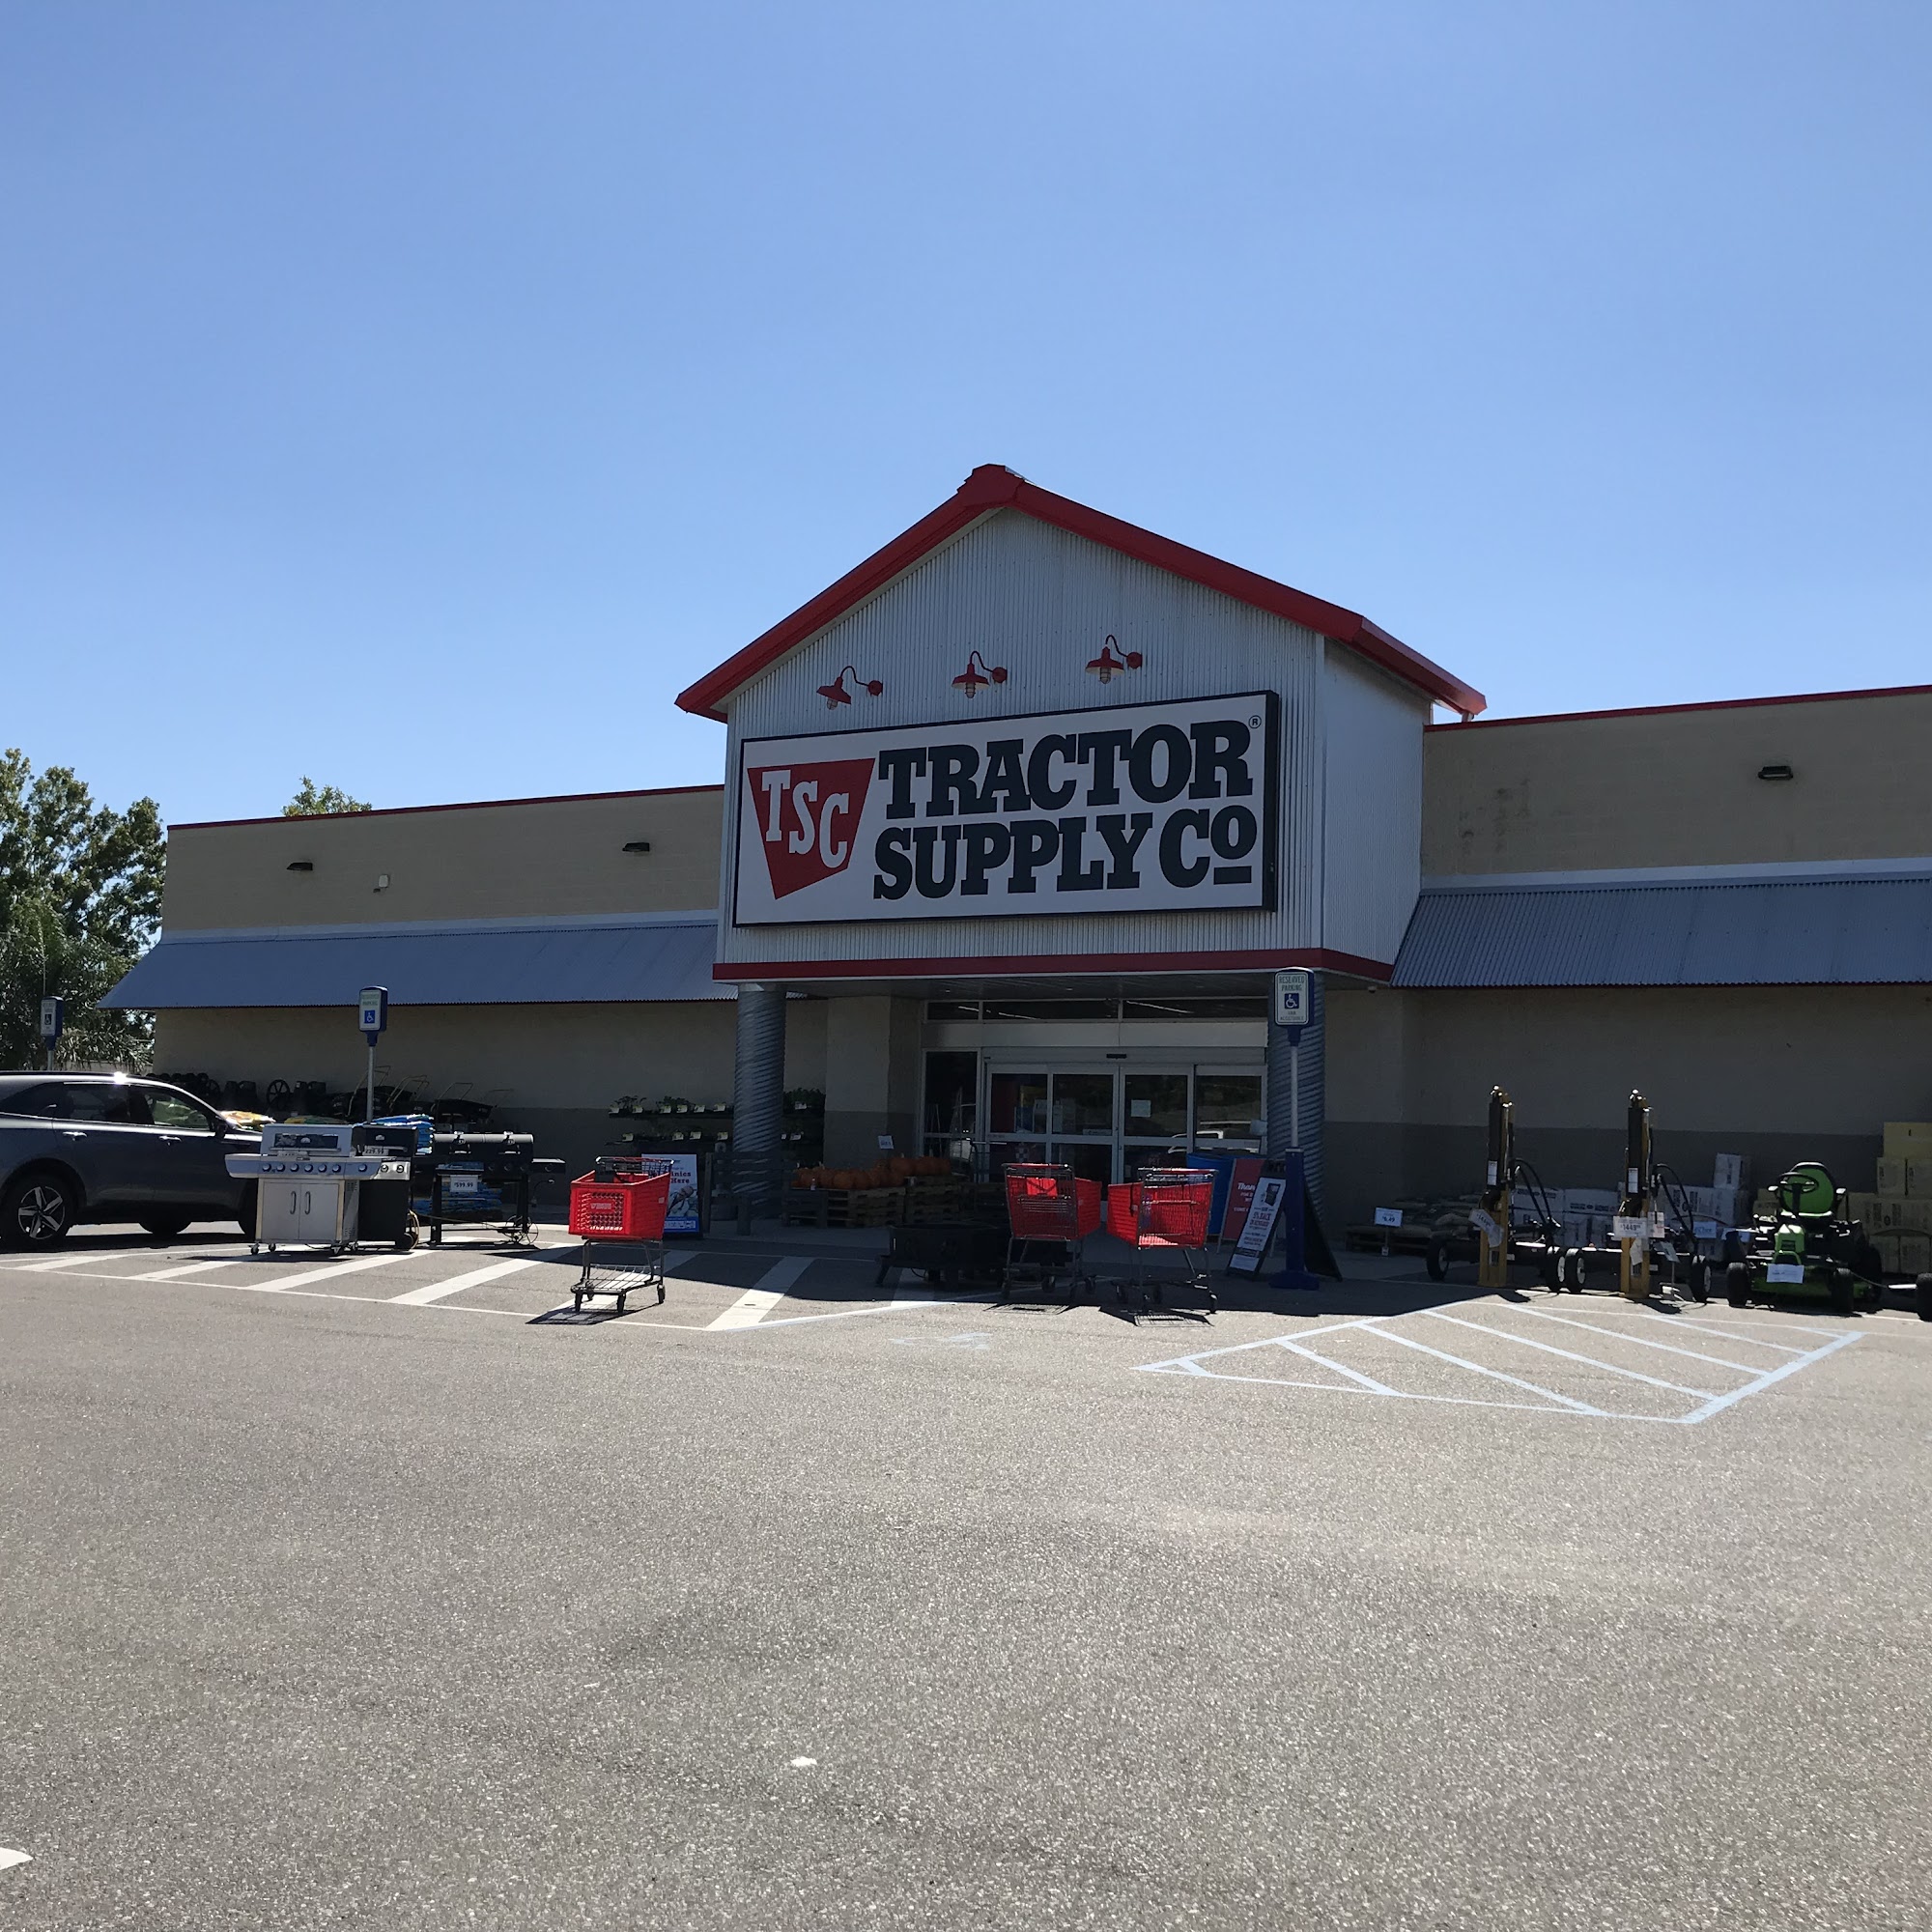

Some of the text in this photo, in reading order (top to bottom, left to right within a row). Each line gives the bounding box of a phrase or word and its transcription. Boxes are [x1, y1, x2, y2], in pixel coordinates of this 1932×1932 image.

[761, 769, 850, 869] TSC
[878, 720, 1253, 820] TRACTOR
[873, 812, 1154, 900] SUPPLY
